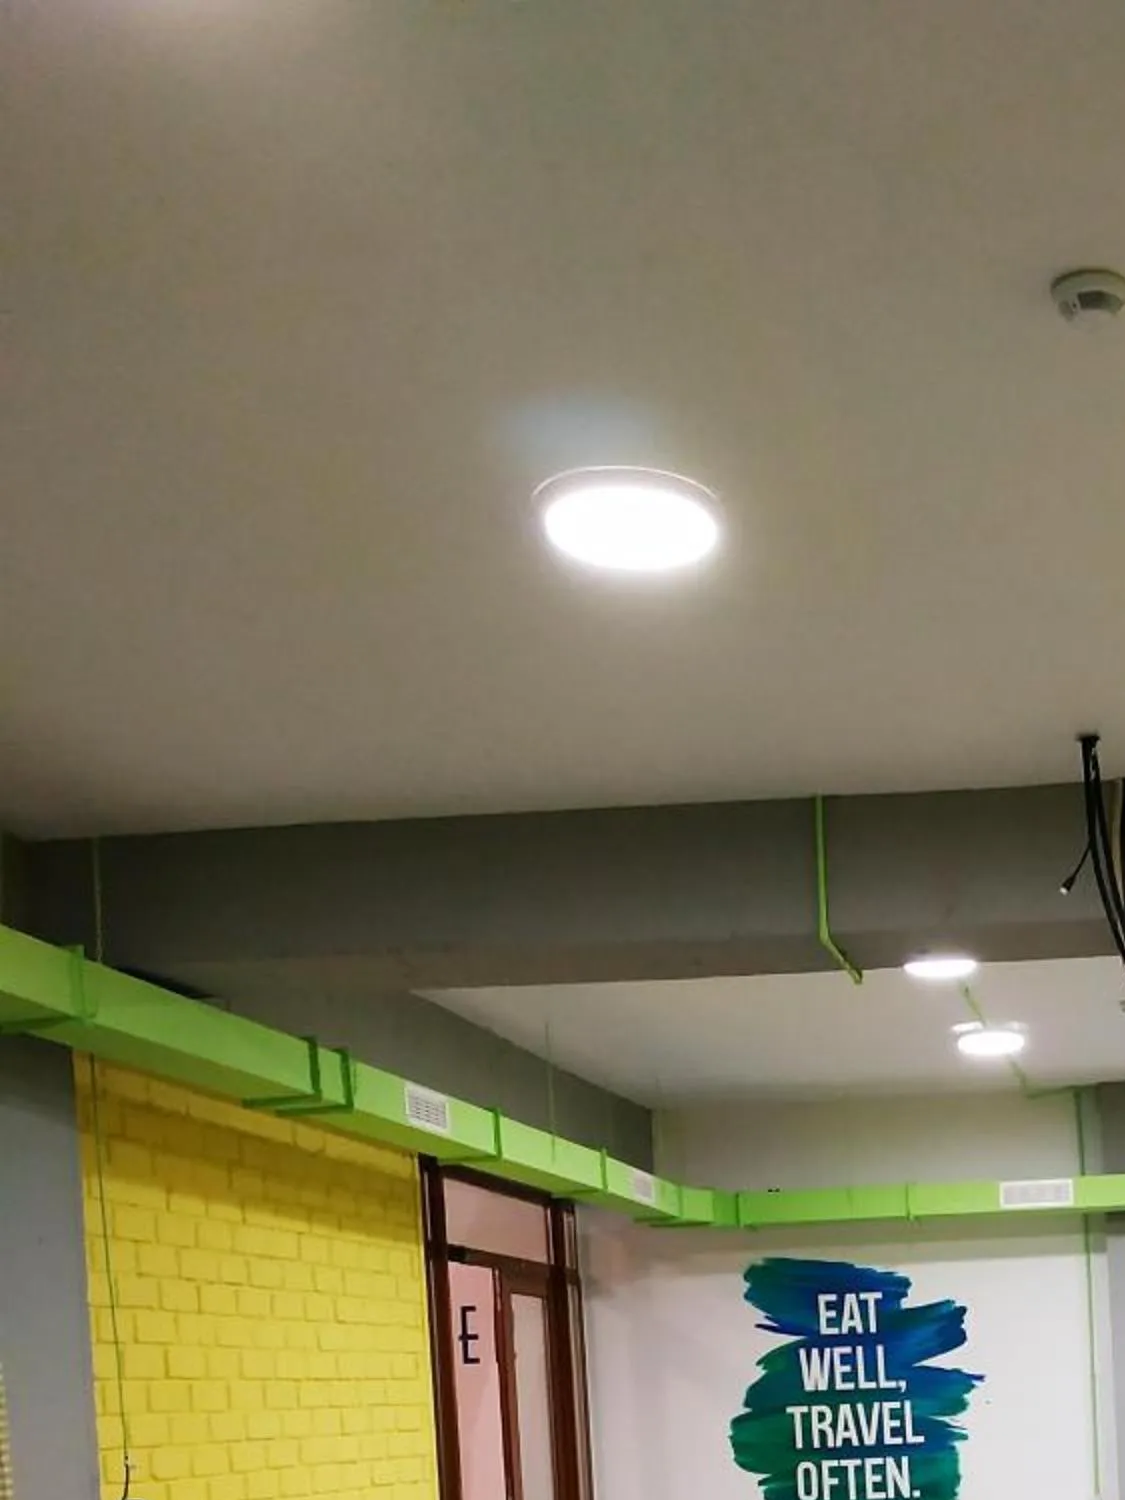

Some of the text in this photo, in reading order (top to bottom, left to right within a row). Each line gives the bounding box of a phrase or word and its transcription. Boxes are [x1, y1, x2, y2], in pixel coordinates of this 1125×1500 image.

[817, 1291, 882, 1335] EAT
[799, 1344, 907, 1392] WELL,
[786, 1400, 925, 1449] TRAVEL
